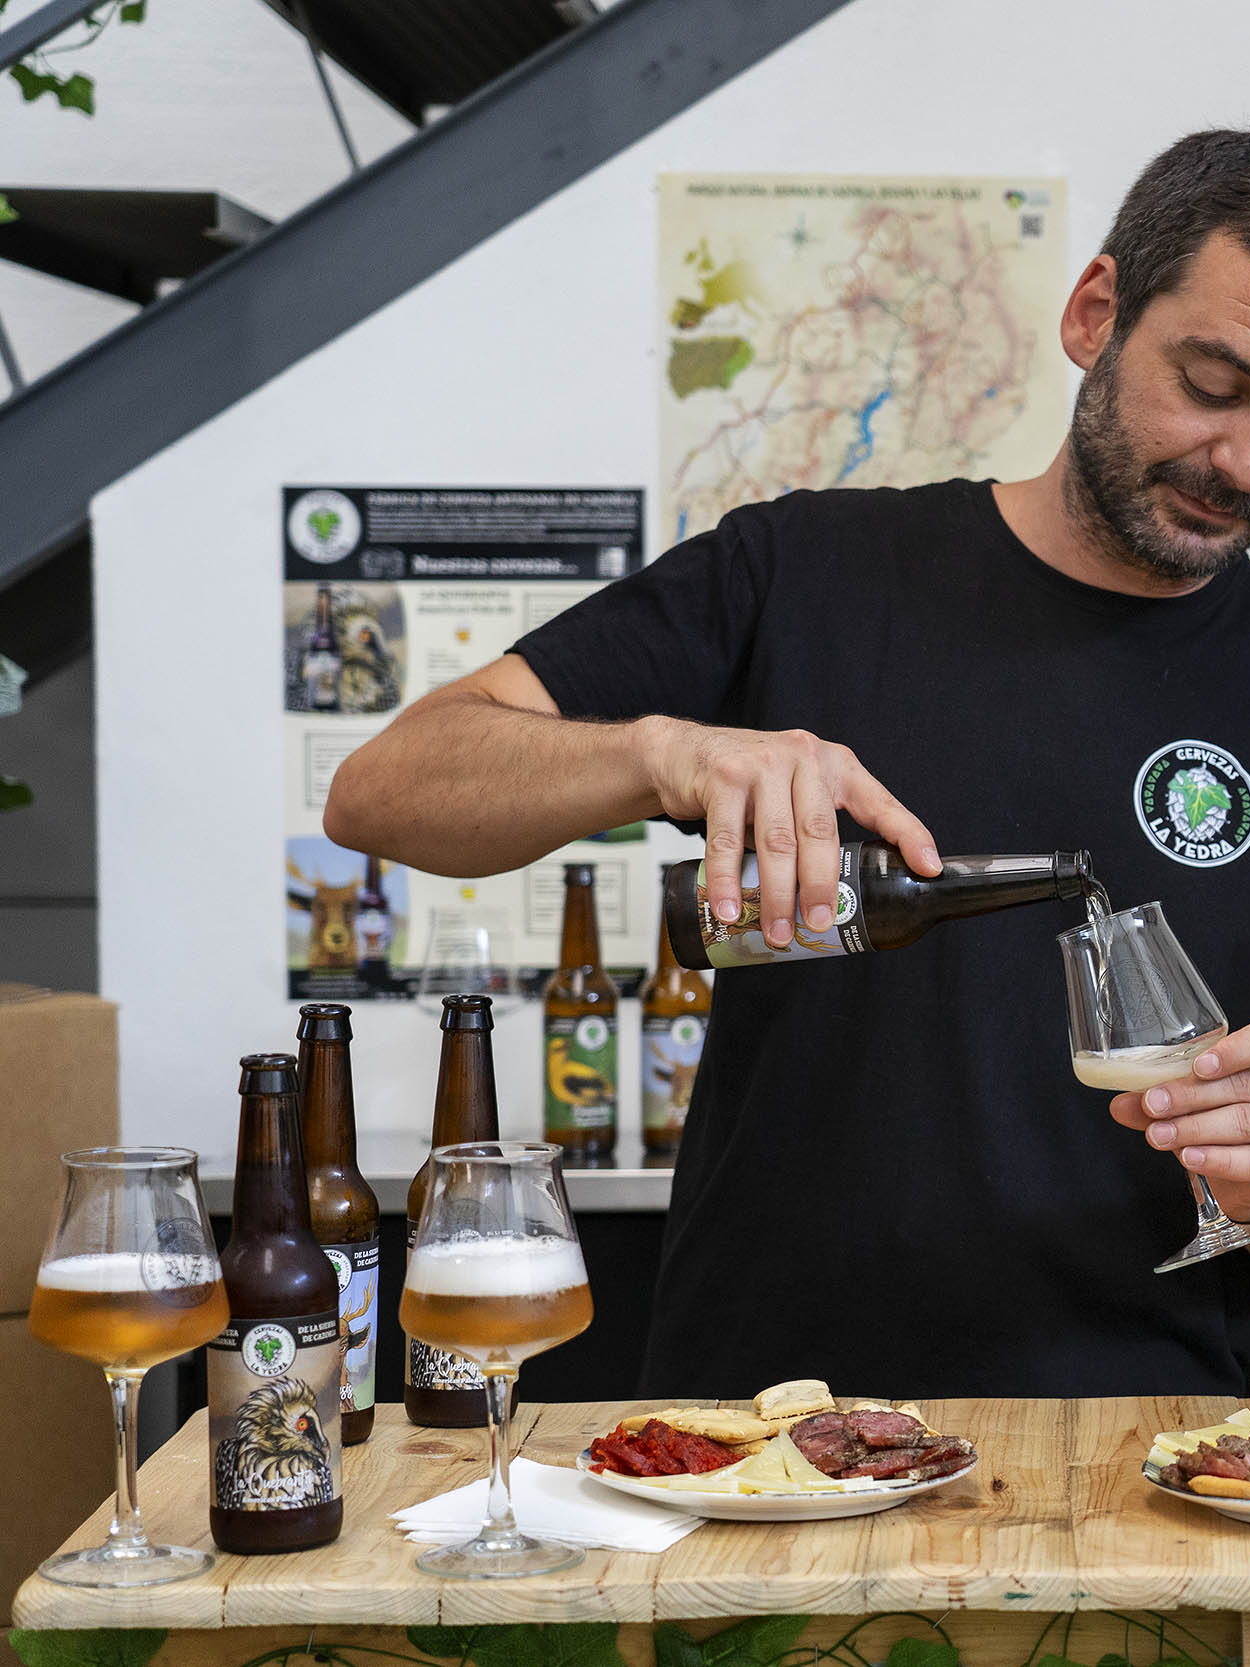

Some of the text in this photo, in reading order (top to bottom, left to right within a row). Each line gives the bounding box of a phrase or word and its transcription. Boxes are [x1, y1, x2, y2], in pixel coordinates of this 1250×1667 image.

[1175, 747, 1240, 781] CERVEZAS
[1149, 817, 1236, 860] LA YEDRA
[297, 1325, 309, 1335] DE
[309, 1323, 319, 1332] LA
[302, 1334, 313, 1344] DE
[262, 1361, 288, 1375] YEDRA
